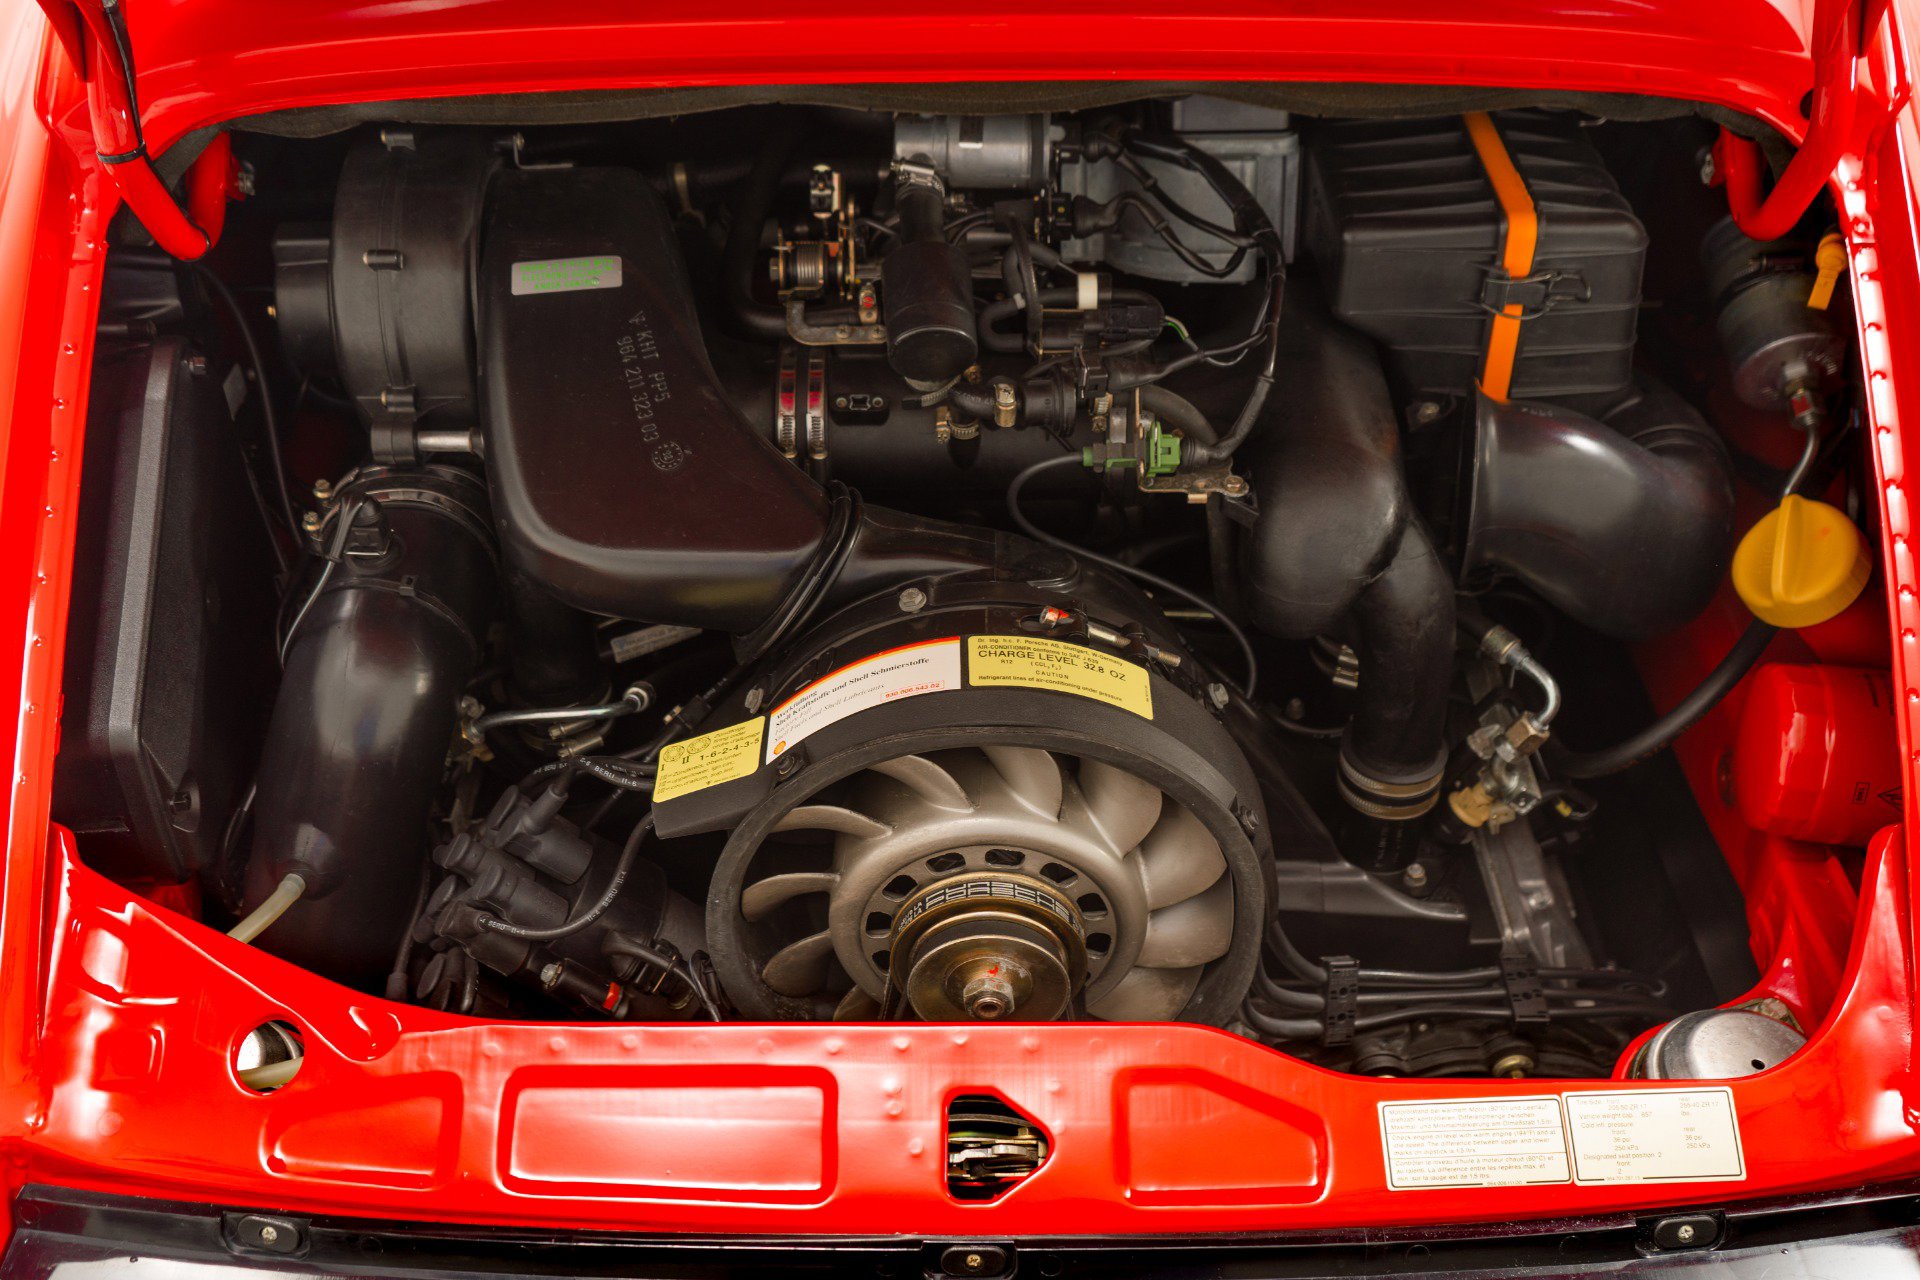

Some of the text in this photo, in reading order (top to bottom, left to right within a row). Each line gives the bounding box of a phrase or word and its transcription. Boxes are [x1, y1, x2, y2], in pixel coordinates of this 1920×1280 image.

[832, 681, 848, 693] und
[849, 673, 869, 685] Shell
[870, 657, 930, 677] Schmierstoffe
[978, 650, 1126, 681] CHARGE LEVEL 32.8 OZ
[1035, 670, 1069, 680] CAUTION
